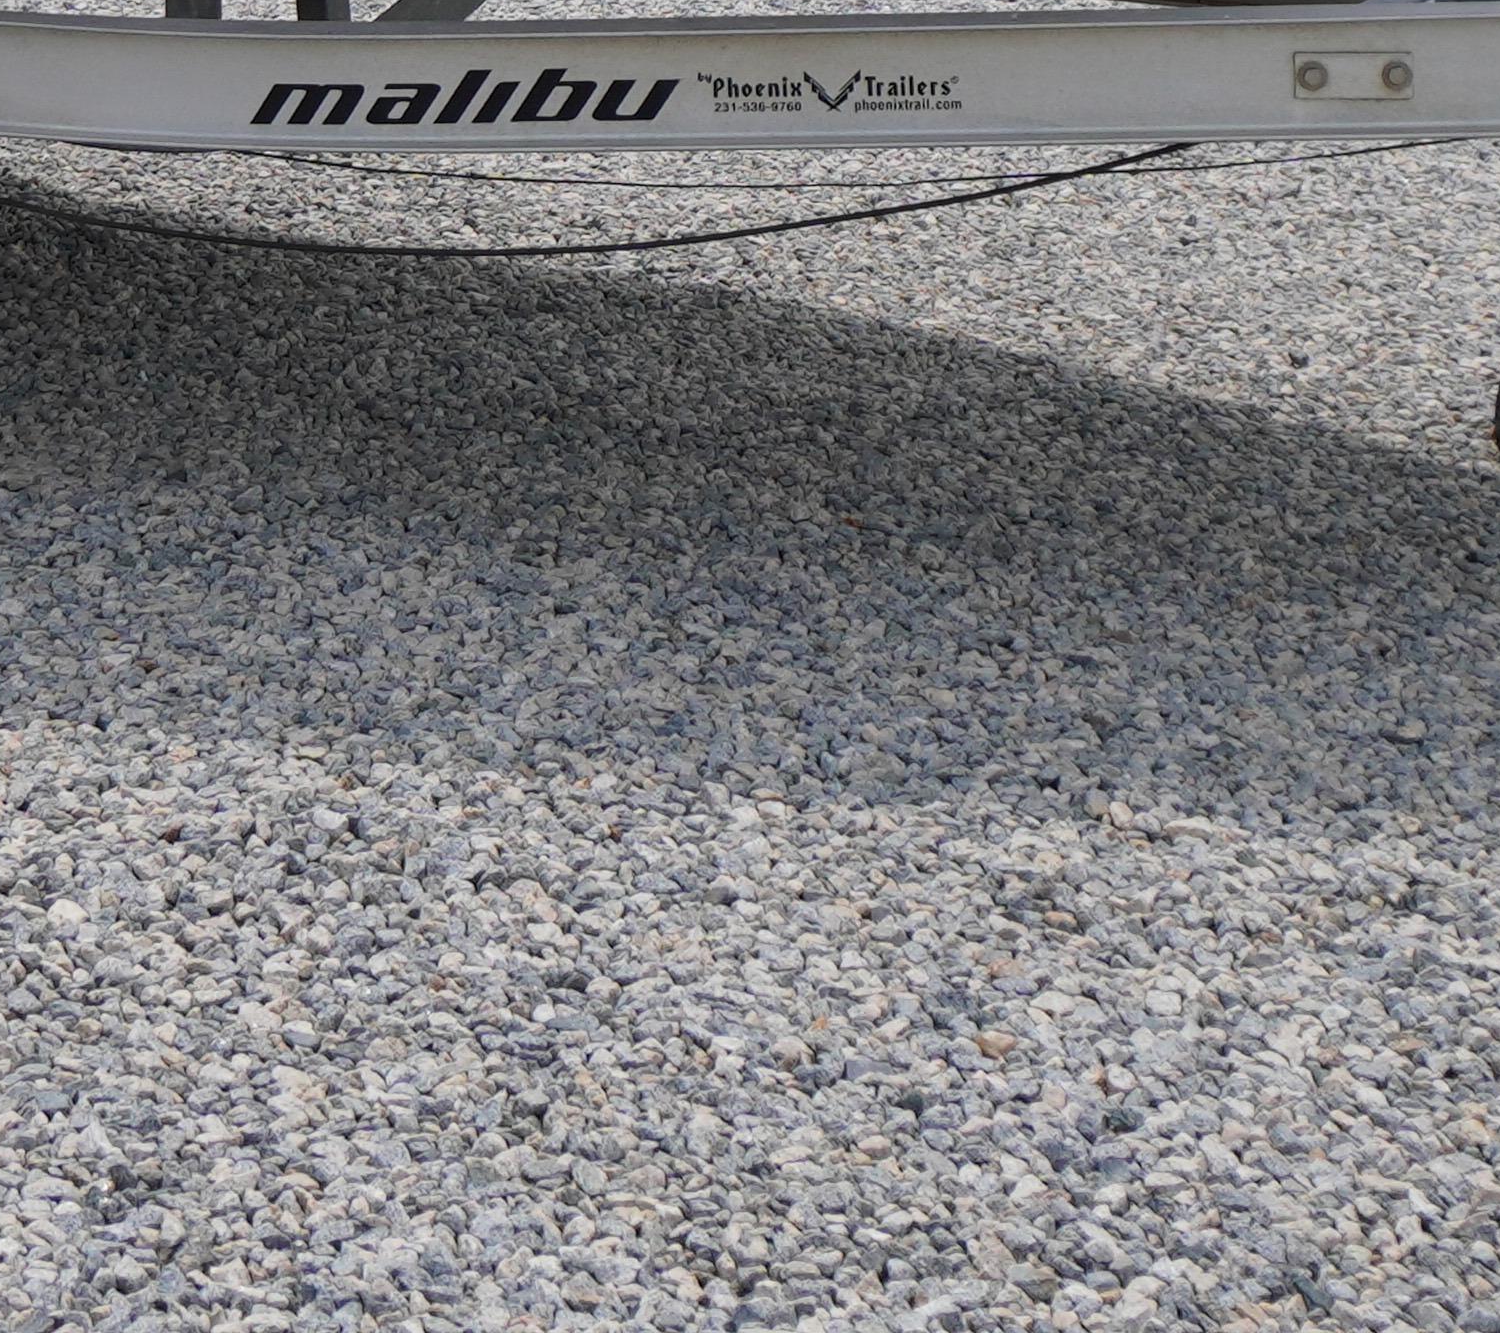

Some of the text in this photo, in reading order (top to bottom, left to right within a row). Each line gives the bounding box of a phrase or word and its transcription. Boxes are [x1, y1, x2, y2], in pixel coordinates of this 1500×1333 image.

[250, 68, 680, 125] malibu
[697, 72, 713, 84] by
[713, 76, 802, 98] Phoenix
[714, 98, 963, 114] 231-536-9760 phoenixtrail.com
